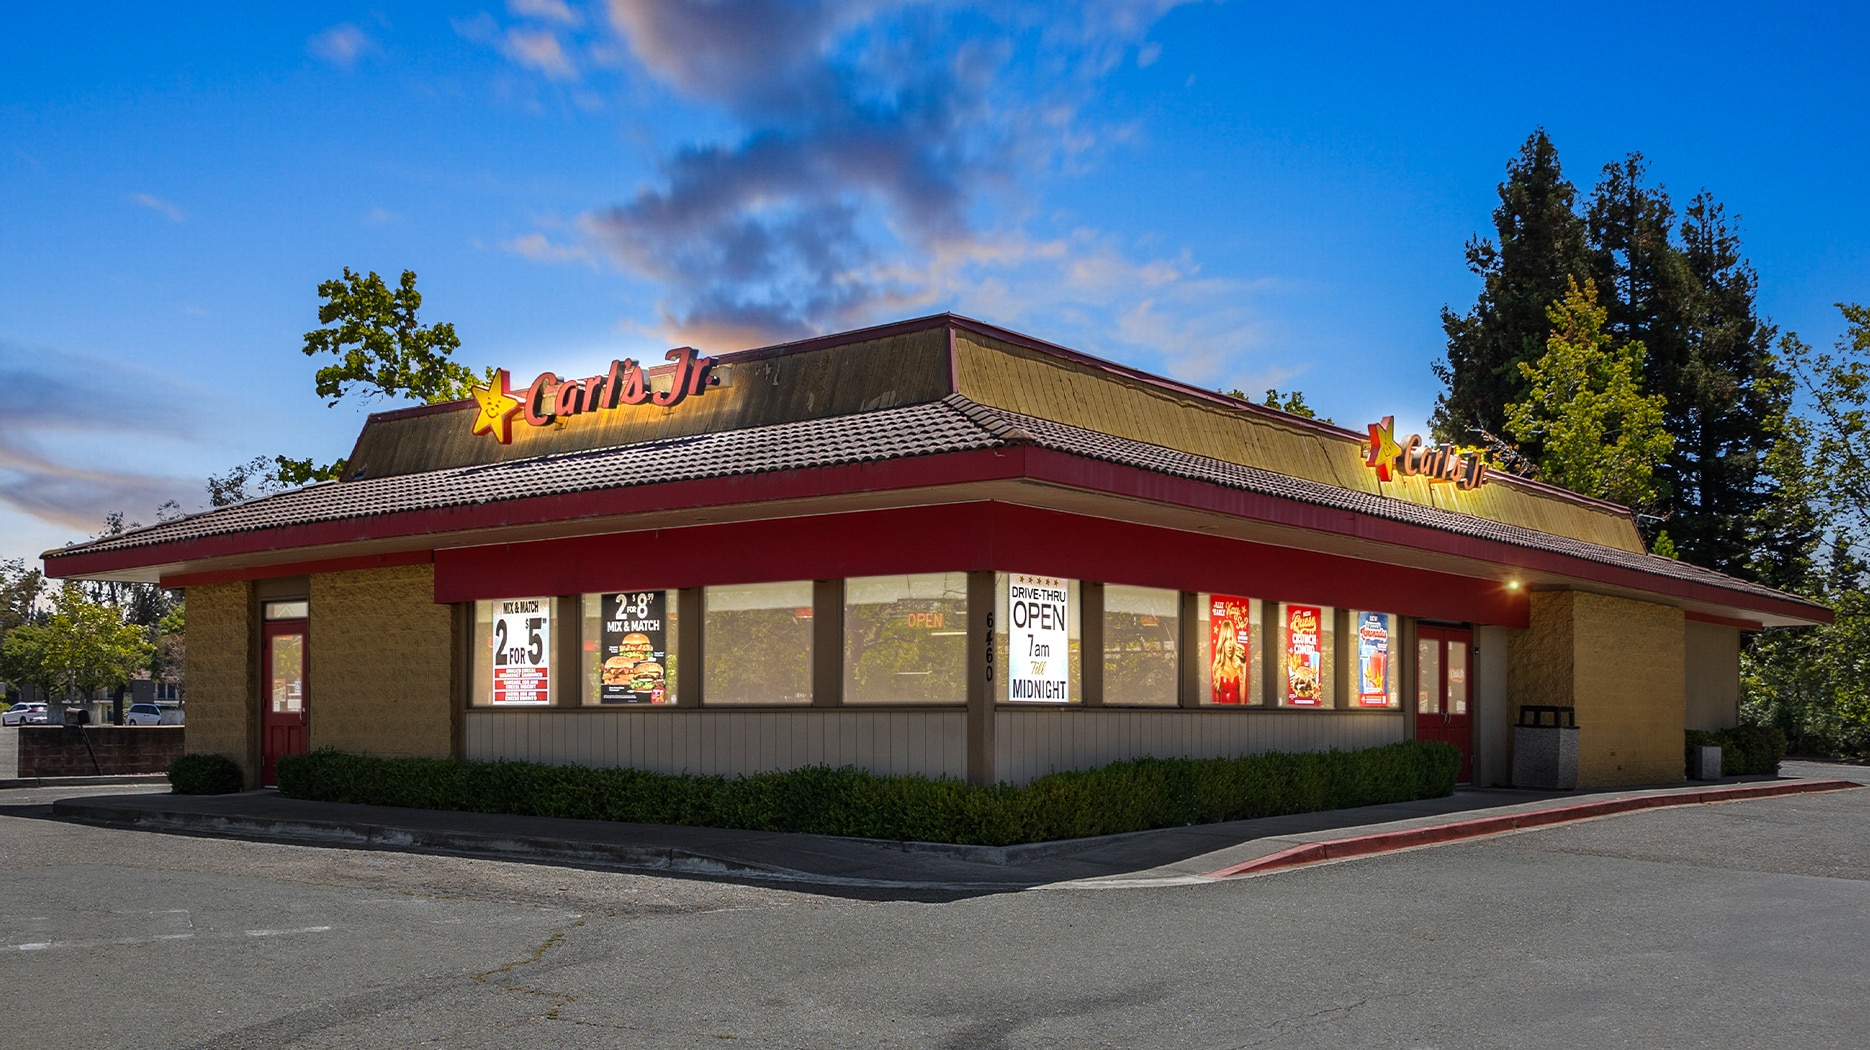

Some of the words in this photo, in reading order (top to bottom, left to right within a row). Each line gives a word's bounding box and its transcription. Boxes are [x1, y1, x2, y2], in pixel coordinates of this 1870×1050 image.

[525, 358, 649, 426] Carl's
[652, 346, 719, 406] Jr.
[1012, 586, 1066, 602] DRIVE-THRU
[503, 602, 515, 614] MIX
[515, 601, 520, 614] &
[520, 600, 539, 613] MATCH
[615, 594, 627, 620] 2
[1013, 600, 1065, 631] OPEN
[607, 621, 623, 632] MIX
[623, 620, 630, 632] &
[631, 620, 660, 631] MATCH
[907, 612, 944, 628] OPEN
[495, 618, 508, 665] 2
[509, 647, 526, 665] FOR
[985, 611, 994, 682] 6460
[1027, 634, 1050, 657] 7am
[1292, 633, 1317, 645] CRUNCH
[1294, 644, 1316, 655] COMBO
[1030, 661, 1047, 675] Till
[1012, 679, 1066, 699] MIDNIGHT
